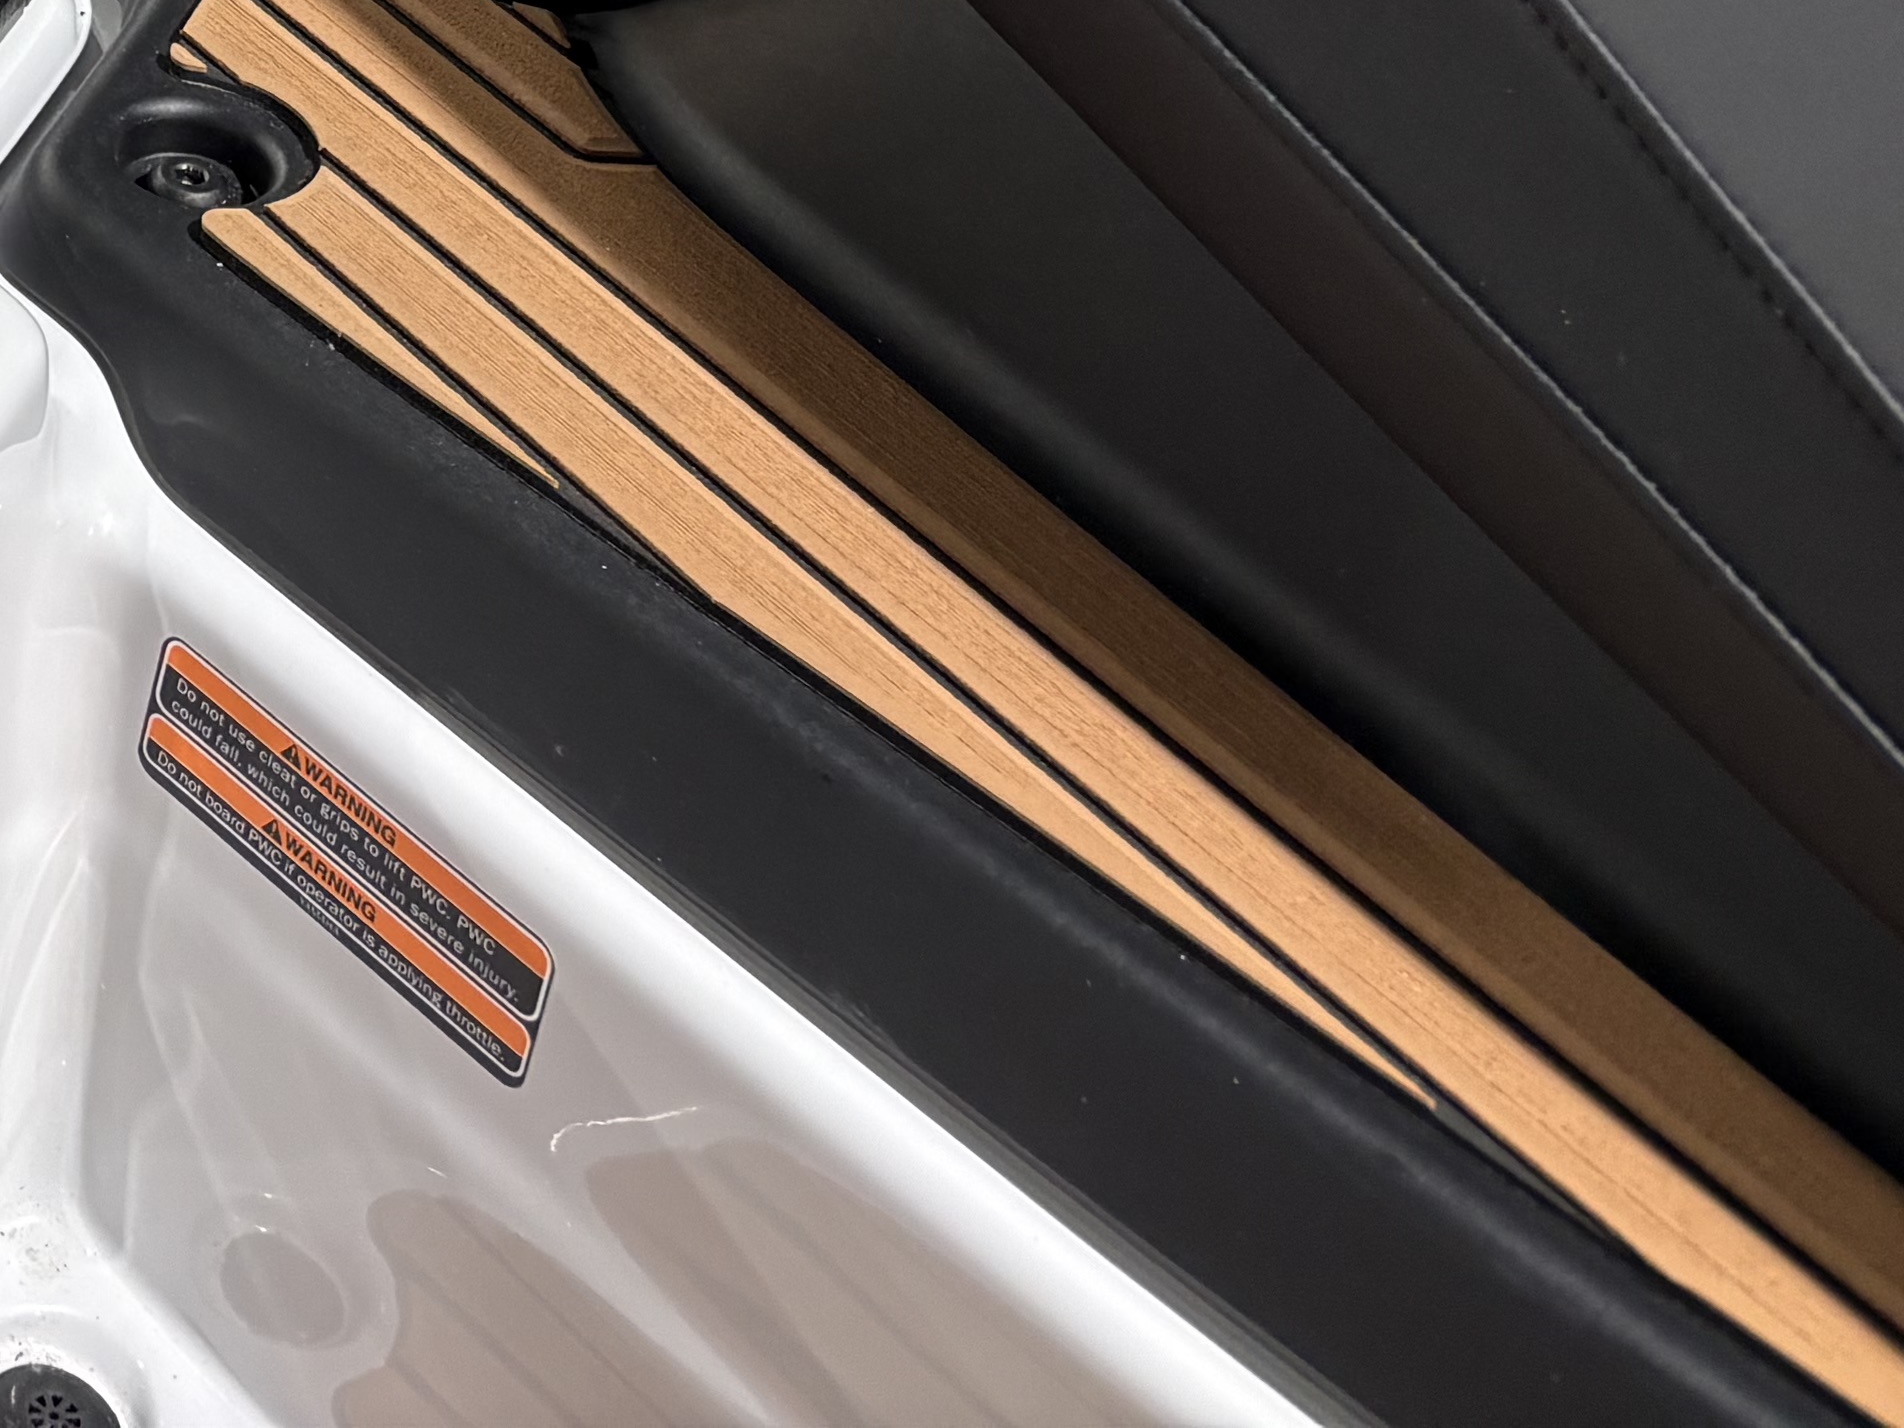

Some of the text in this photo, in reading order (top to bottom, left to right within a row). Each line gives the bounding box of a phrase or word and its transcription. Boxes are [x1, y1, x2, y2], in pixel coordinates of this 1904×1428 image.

[157, 750, 177, 775] Do
[179, 772, 203, 798] not
[205, 791, 245, 834] board
[248, 828, 282, 865] PWC
[284, 858, 294, 876] if
[297, 875, 361, 931] operator
[362, 929, 375, 948] is
[379, 945, 442, 1009] applying
[445, 1000, 506, 1062] throttle.
[171, 700, 519, 1003] could fall, which could result in severe injury.
[177, 677, 196, 702] Do
[200, 700, 225, 726] not
[228, 724, 256, 752] use
[259, 749, 297, 788] cleat
[300, 785, 318, 803] or
[320, 802, 359, 841] grips
[364, 837, 379, 858] to
[384, 852, 406, 882] lift
[456, 914, 497, 955] PWC
[285, 832, 376, 923] WARNING
[304, 756, 396, 846] WARNING
